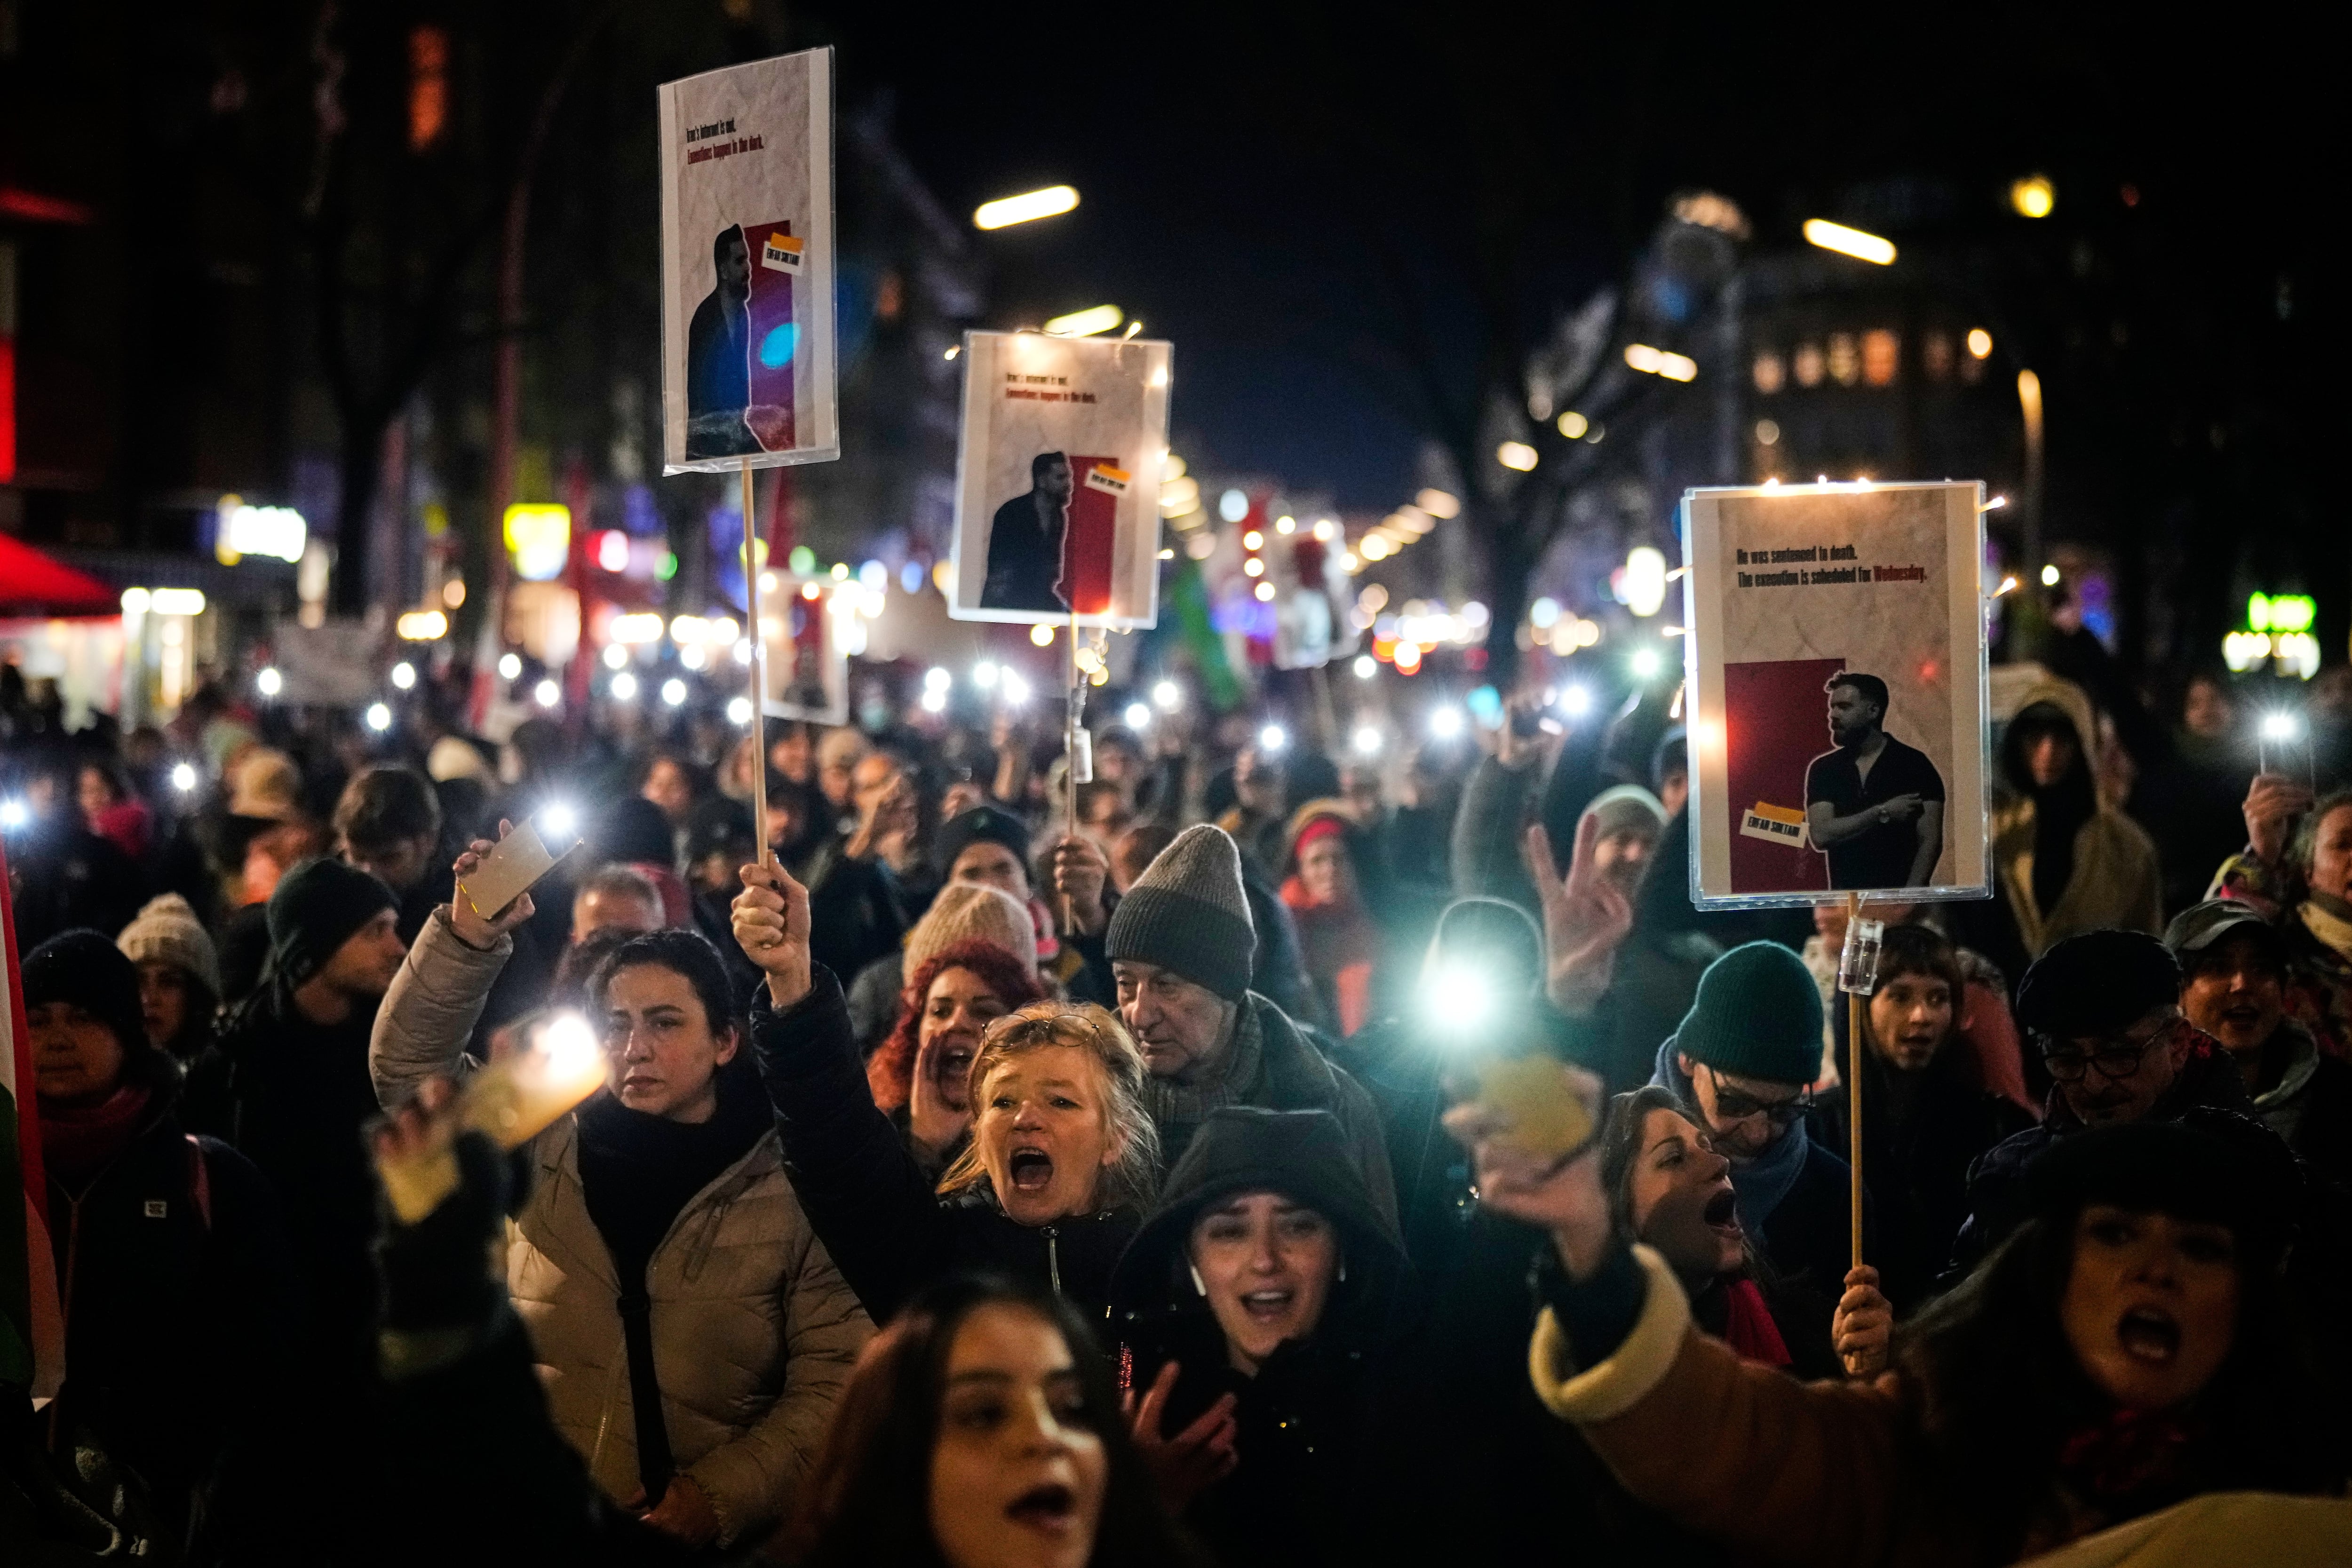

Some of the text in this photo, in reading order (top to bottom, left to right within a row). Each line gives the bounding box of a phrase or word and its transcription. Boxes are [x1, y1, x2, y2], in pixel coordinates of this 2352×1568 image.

[1737, 544, 1858, 565] He was sentenced to death.
[1738, 572, 1753, 588] The
[1755, 569, 1798, 587] execution
[1801, 569, 1809, 585] is
[1811, 567, 1856, 584] scheduled
[1859, 566, 1872, 582] for
